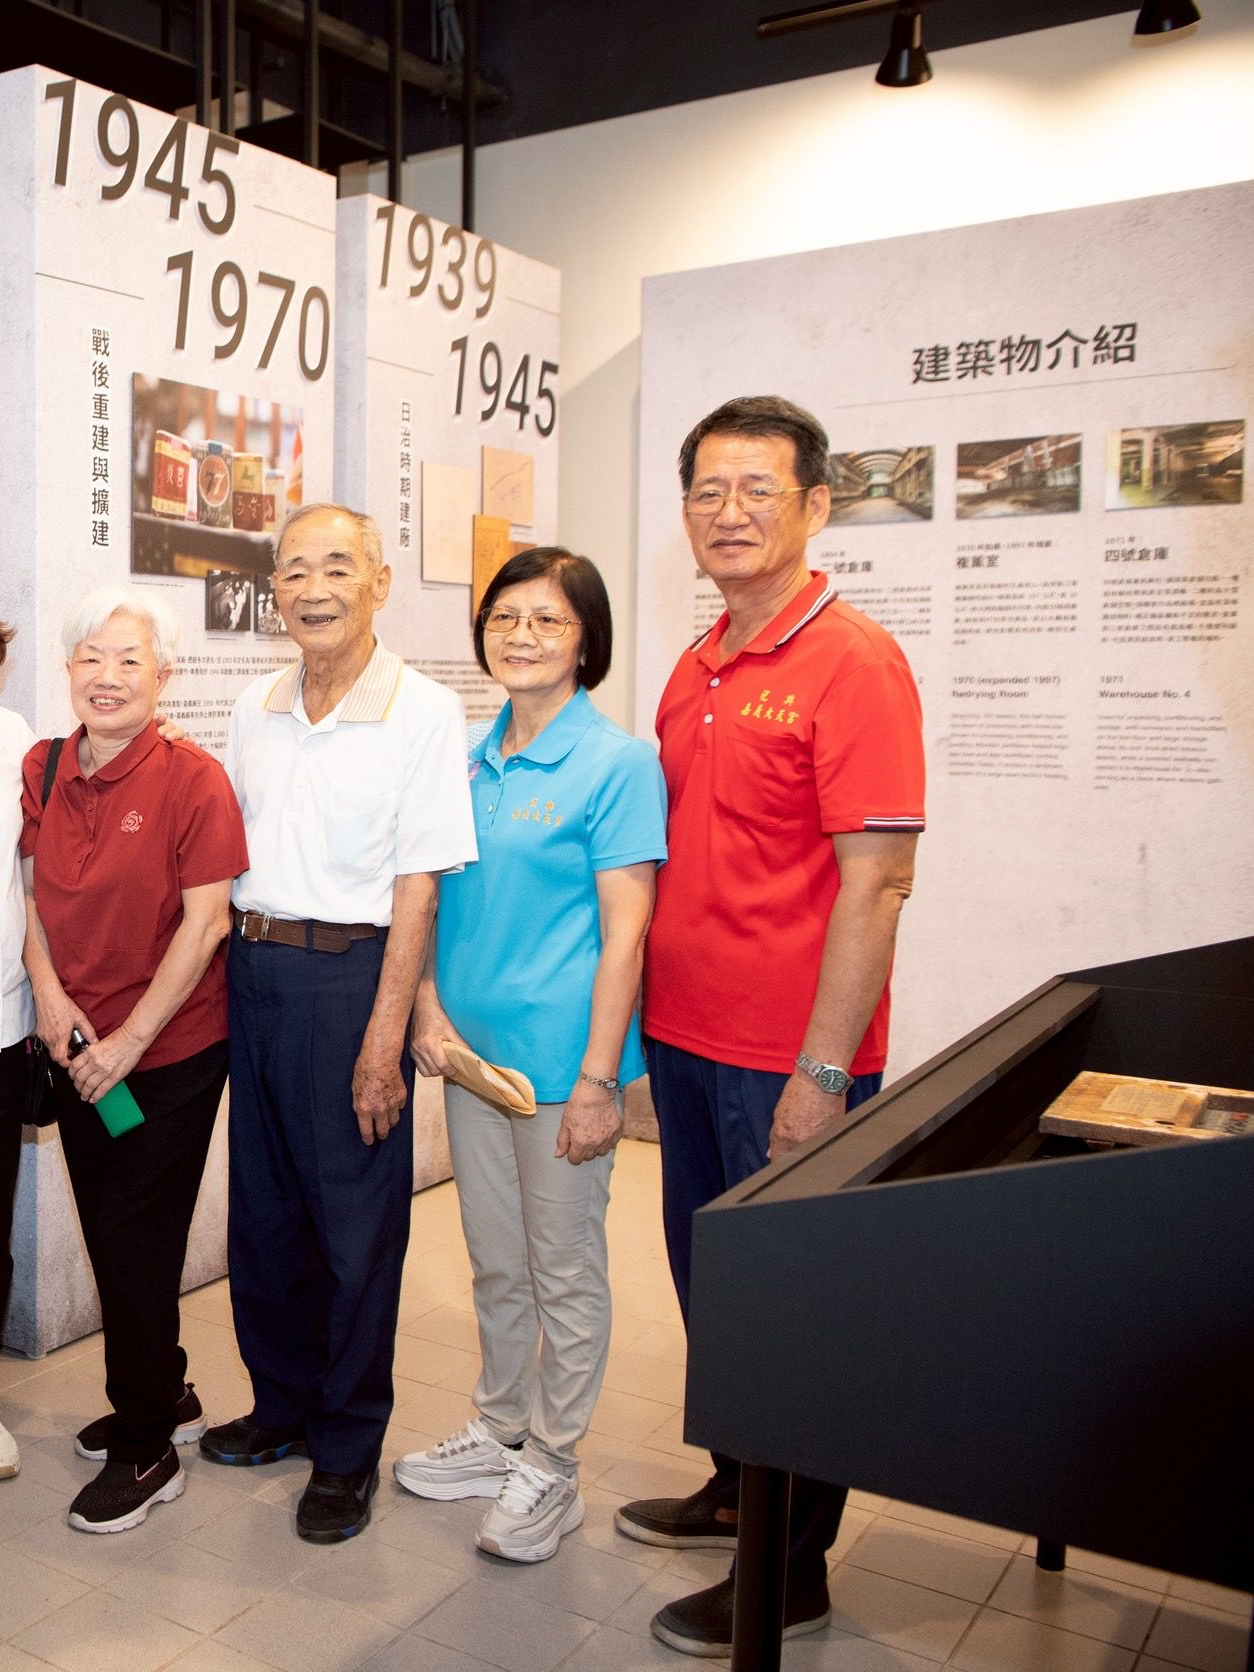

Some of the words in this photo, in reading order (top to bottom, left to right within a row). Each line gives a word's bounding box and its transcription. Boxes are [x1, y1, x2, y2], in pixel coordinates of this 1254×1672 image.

[44, 78, 241, 236] 1945
[166, 250, 331, 382] 1970
[375, 204, 497, 319] 1939
[450, 335, 560, 439] 1945
[912, 321, 1139, 384] 建築物介紹
[91, 328, 110, 547] 戰後重建與擴建
